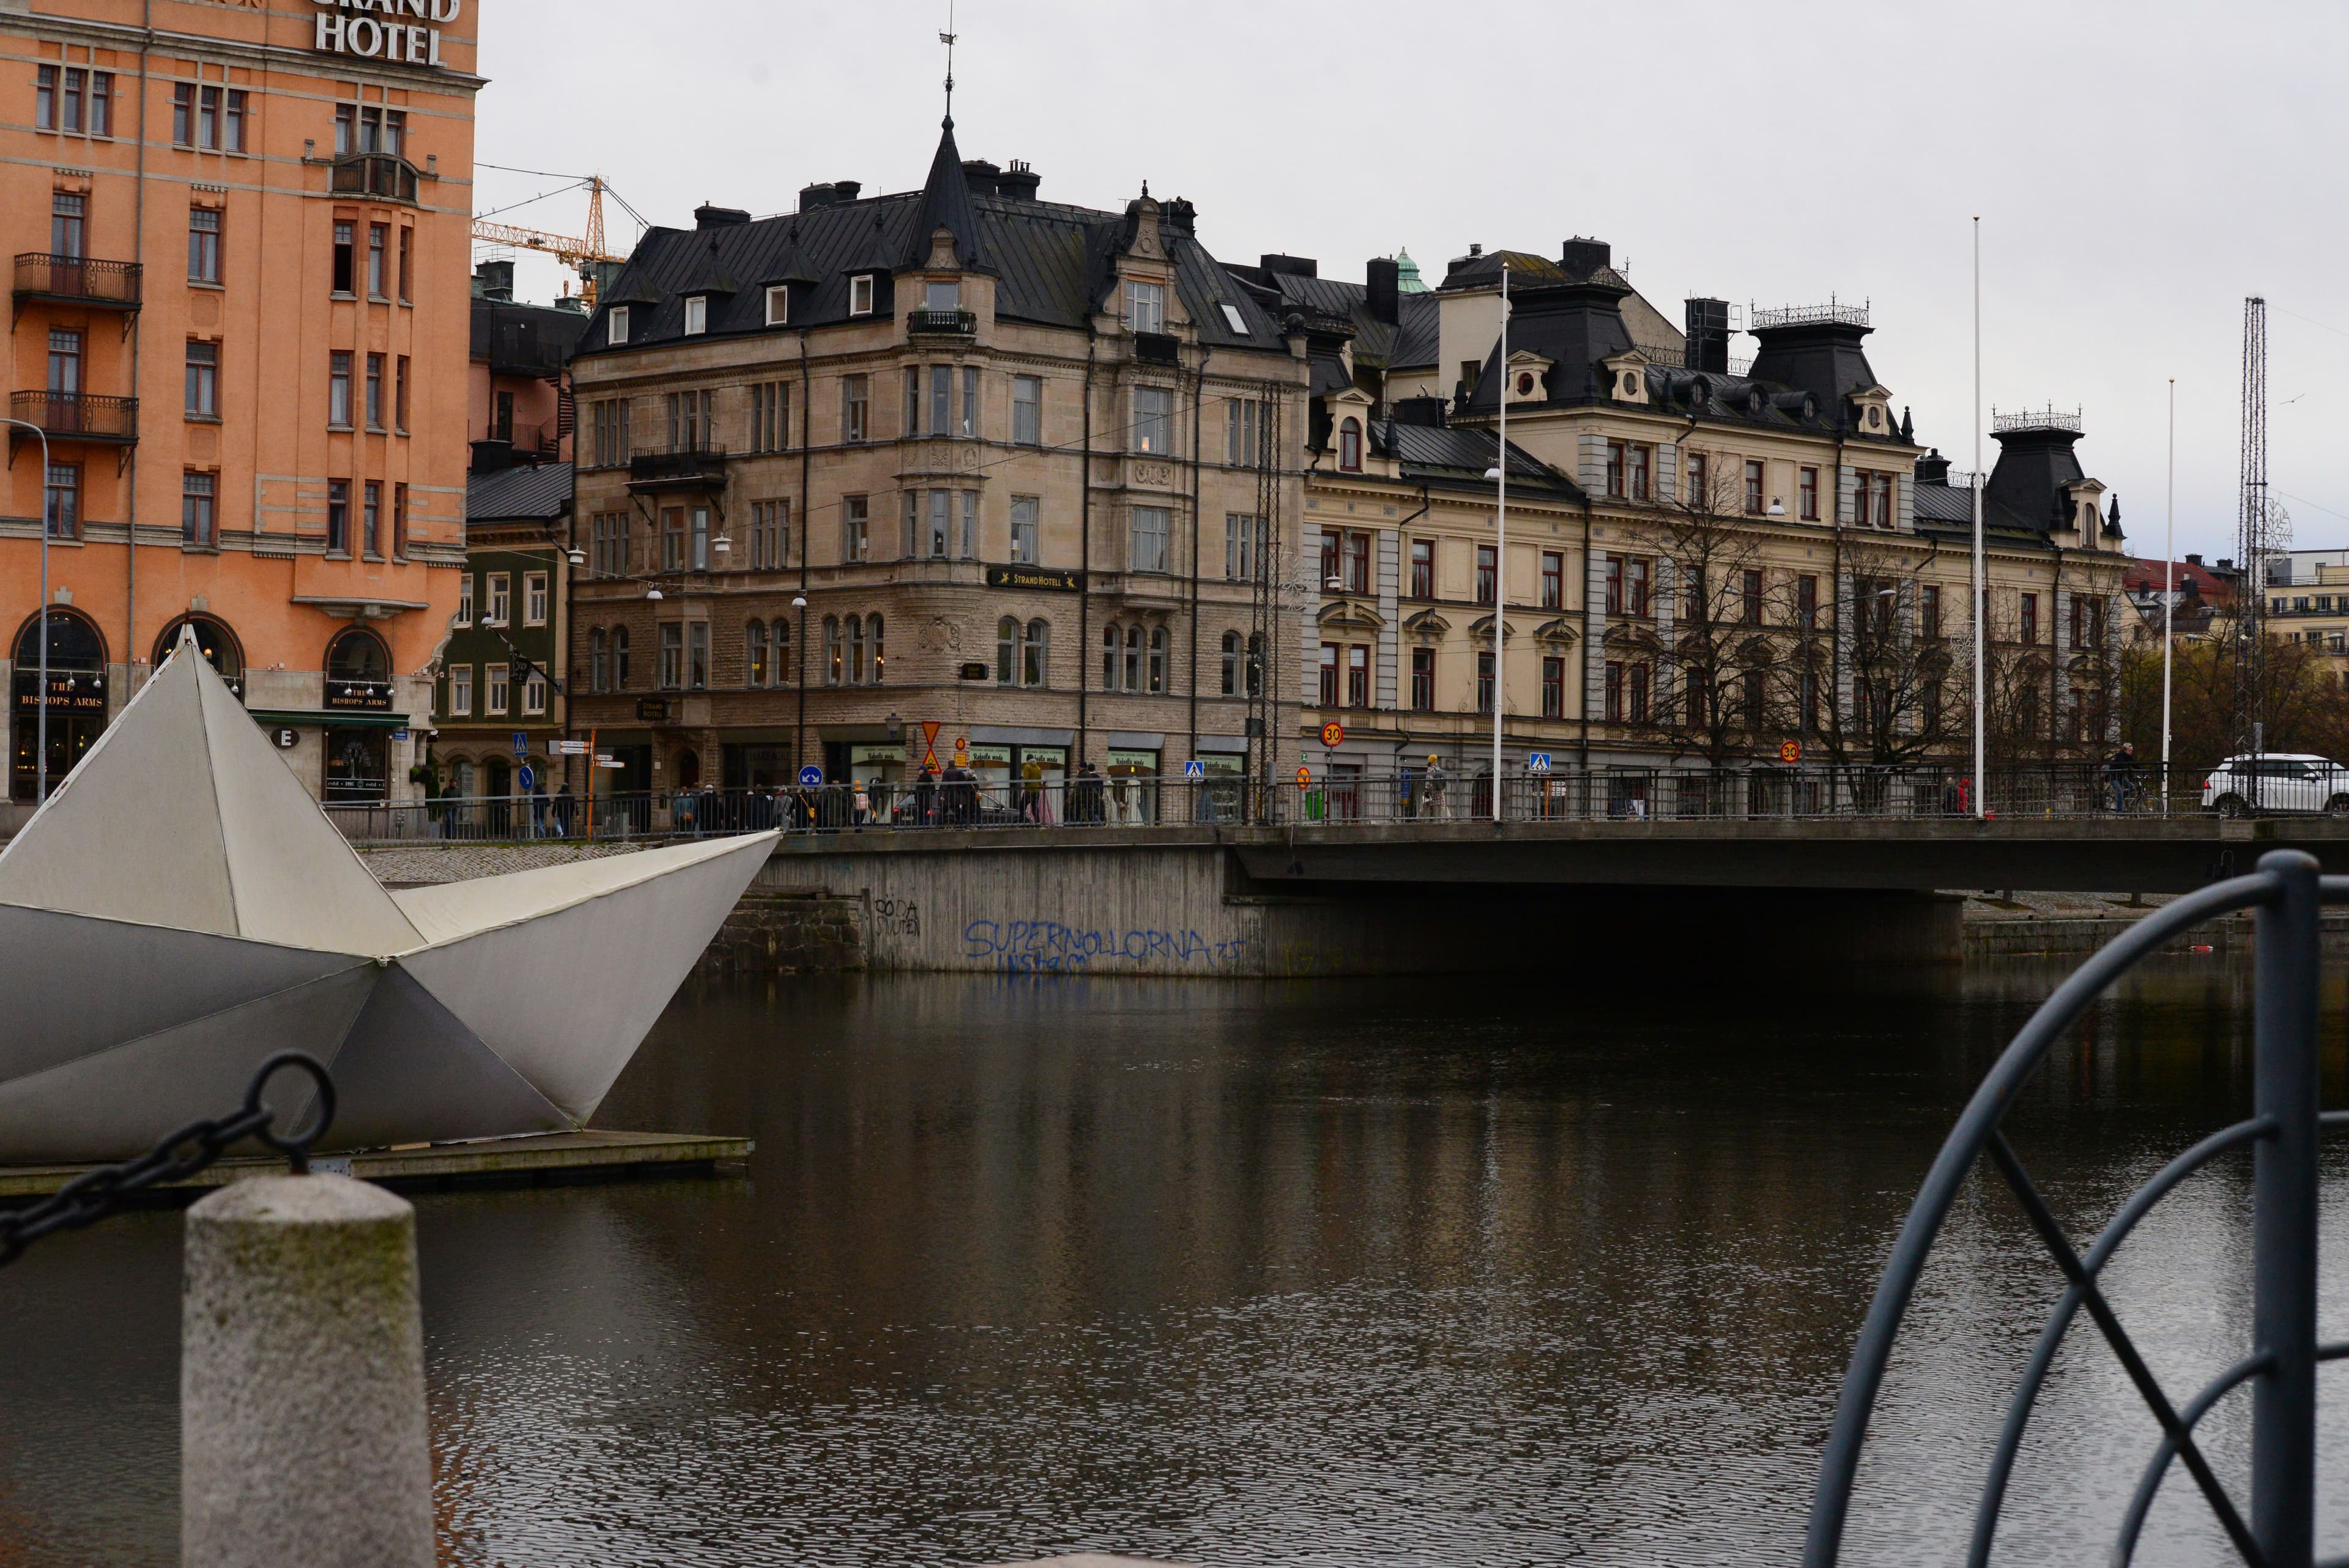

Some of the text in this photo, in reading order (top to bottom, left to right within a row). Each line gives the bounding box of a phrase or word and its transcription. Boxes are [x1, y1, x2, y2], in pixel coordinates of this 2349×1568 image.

[316, 12, 447, 67] HOTEL
[1014, 574, 1061, 586] STRAND HOTELL
[21, 695, 103, 707] BISOPS ARMS
[281, 730, 292, 746] E
[1326, 729, 1340, 740] 30
[1784, 747, 1797, 757] 30
[875, 893, 916, 919] DÖDA
[877, 916, 920, 937] SNUTEN
[965, 920, 1214, 969] SUPERNOLLORNA
